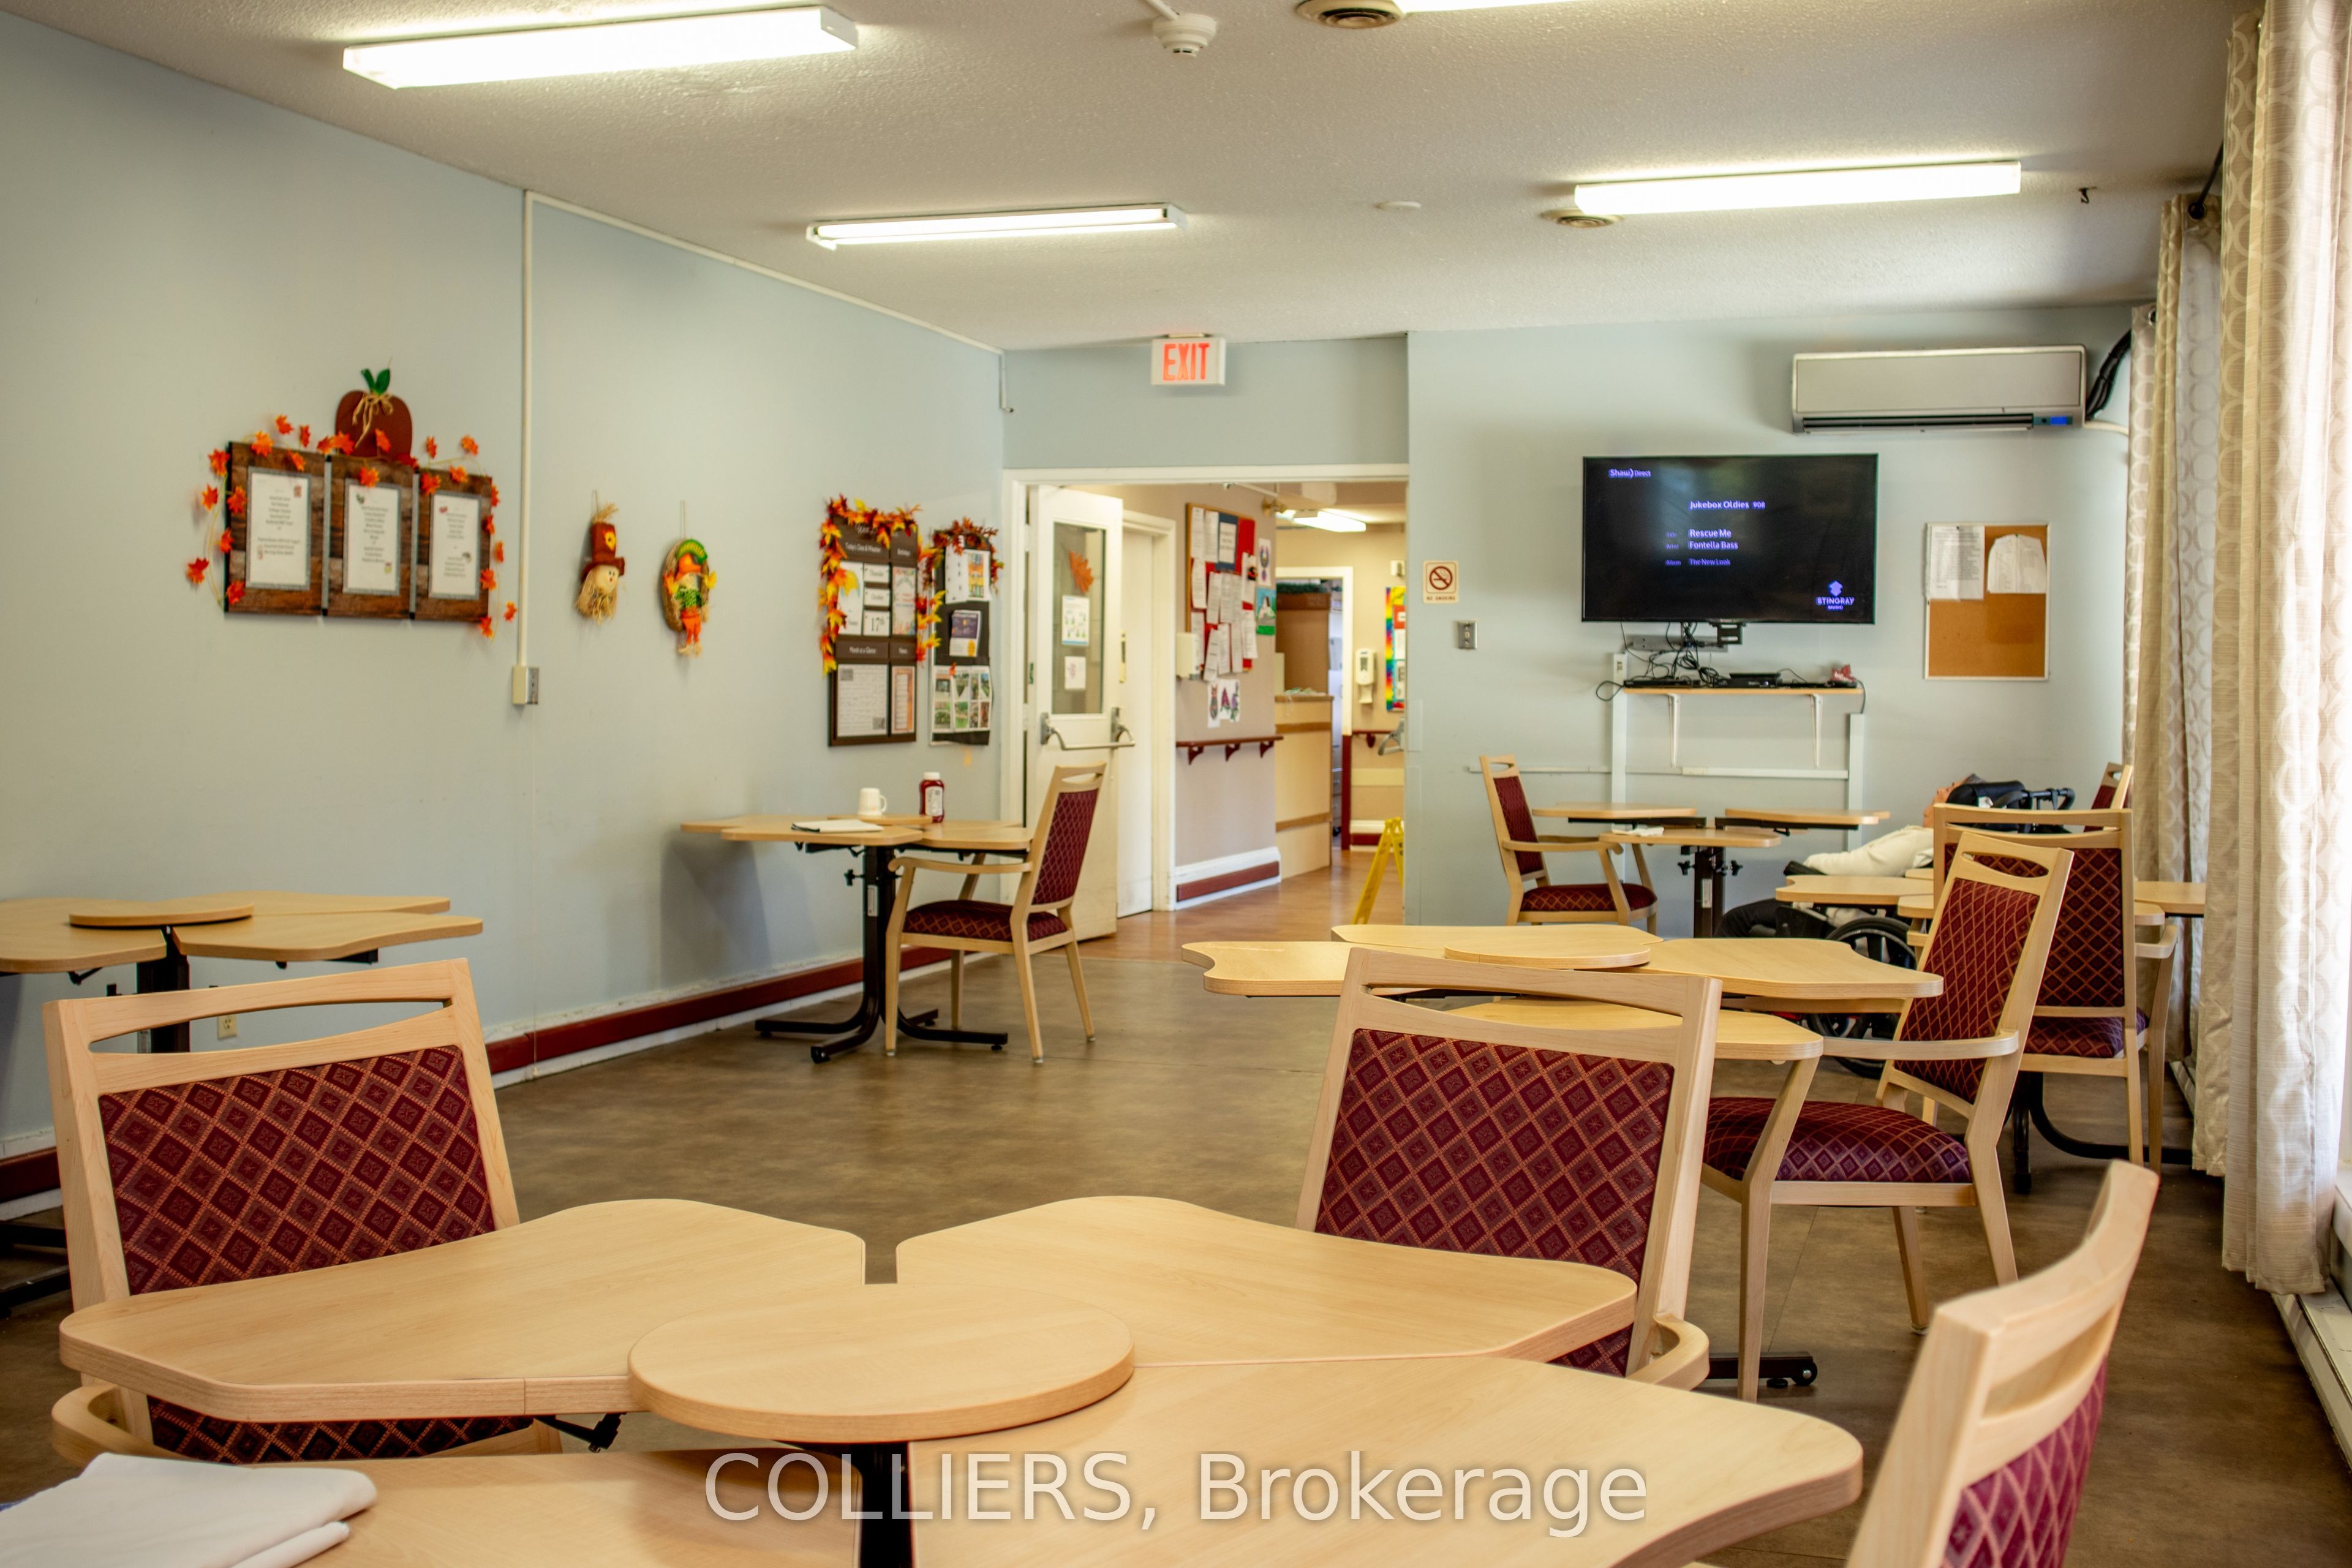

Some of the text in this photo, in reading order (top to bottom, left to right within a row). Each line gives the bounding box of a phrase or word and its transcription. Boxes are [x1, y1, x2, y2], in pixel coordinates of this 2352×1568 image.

[1163, 343, 1210, 381] EXIT
[1689, 500, 1766, 510] Jukebox Oldies 908
[1689, 529, 1732, 538] Rescue Me
[1689, 541, 1738, 550] Fontella Bass
[1815, 597, 1855, 605] STINGRAY
